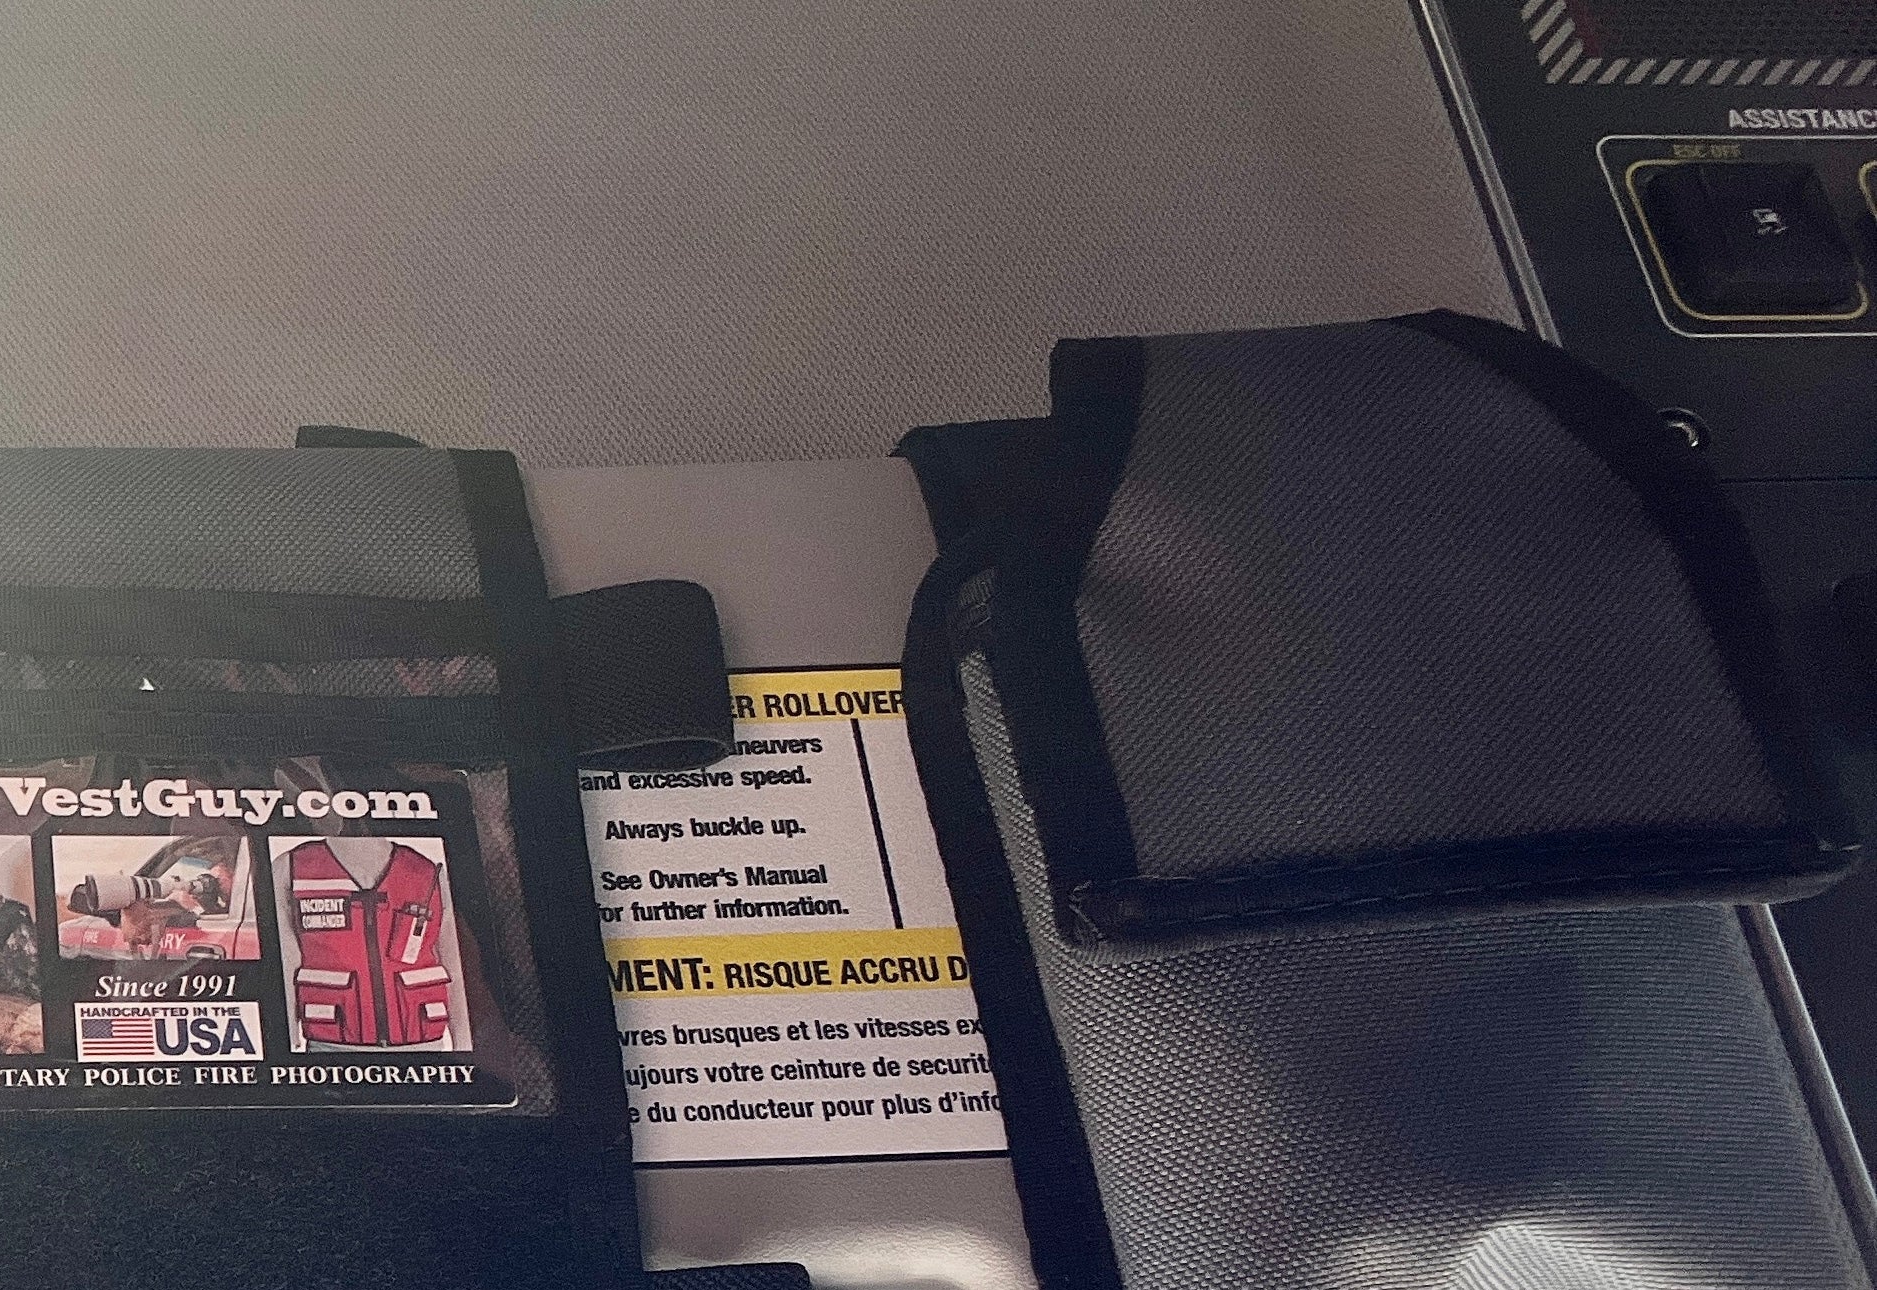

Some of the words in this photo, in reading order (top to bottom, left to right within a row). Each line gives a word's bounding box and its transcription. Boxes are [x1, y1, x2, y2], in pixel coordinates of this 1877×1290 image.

[1728, 108, 1877, 130] ASSISTANC
[763, 690, 903, 717] ROLLOVER
[580, 769, 620, 791] and
[628, 768, 734, 789] excessive
[741, 765, 812, 790] speed.
[605, 820, 684, 842] Always
[690, 816, 764, 837] buckle
[771, 818, 807, 838] up.
[600, 871, 643, 891] See
[649, 868, 739, 890] Owner's
[744, 864, 828, 887] Manual
[631, 901, 707, 922] further
[713, 896, 850, 919] information.
[724, 960, 833, 989] RISQUE
[840, 956, 940, 985] ACCRU
[947, 955, 969, 981] D
[95, 975, 168, 998] Since
[178, 974, 236, 997] 1991
[80, 1007, 189, 1018] HANDCRAFTED
[193, 1007, 208, 1017] IN
[212, 1006, 240, 1017] THE
[154, 1018, 256, 1056] USA
[673, 1024, 780, 1047] brusques
[787, 1021, 810, 1041] et
[815, 1019, 849, 1040] les
[854, 1018, 950, 1039] vitesses
[83, 1066, 181, 1087] POLICE
[194, 1065, 258, 1085] FIRE
[271, 1064, 475, 1085] PHOTOGRAPHY
[625, 1064, 699, 1090] ujours
[704, 1062, 764, 1083] votre
[771, 1058, 866, 1080] ceinture
[873, 1056, 901, 1077] de
[907, 1053, 991, 1076] securit
[647, 1102, 677, 1122] du
[683, 1099, 815, 1121] conducteur
[822, 1099, 874, 1121] pour
[882, 1094, 932, 1119] plus
